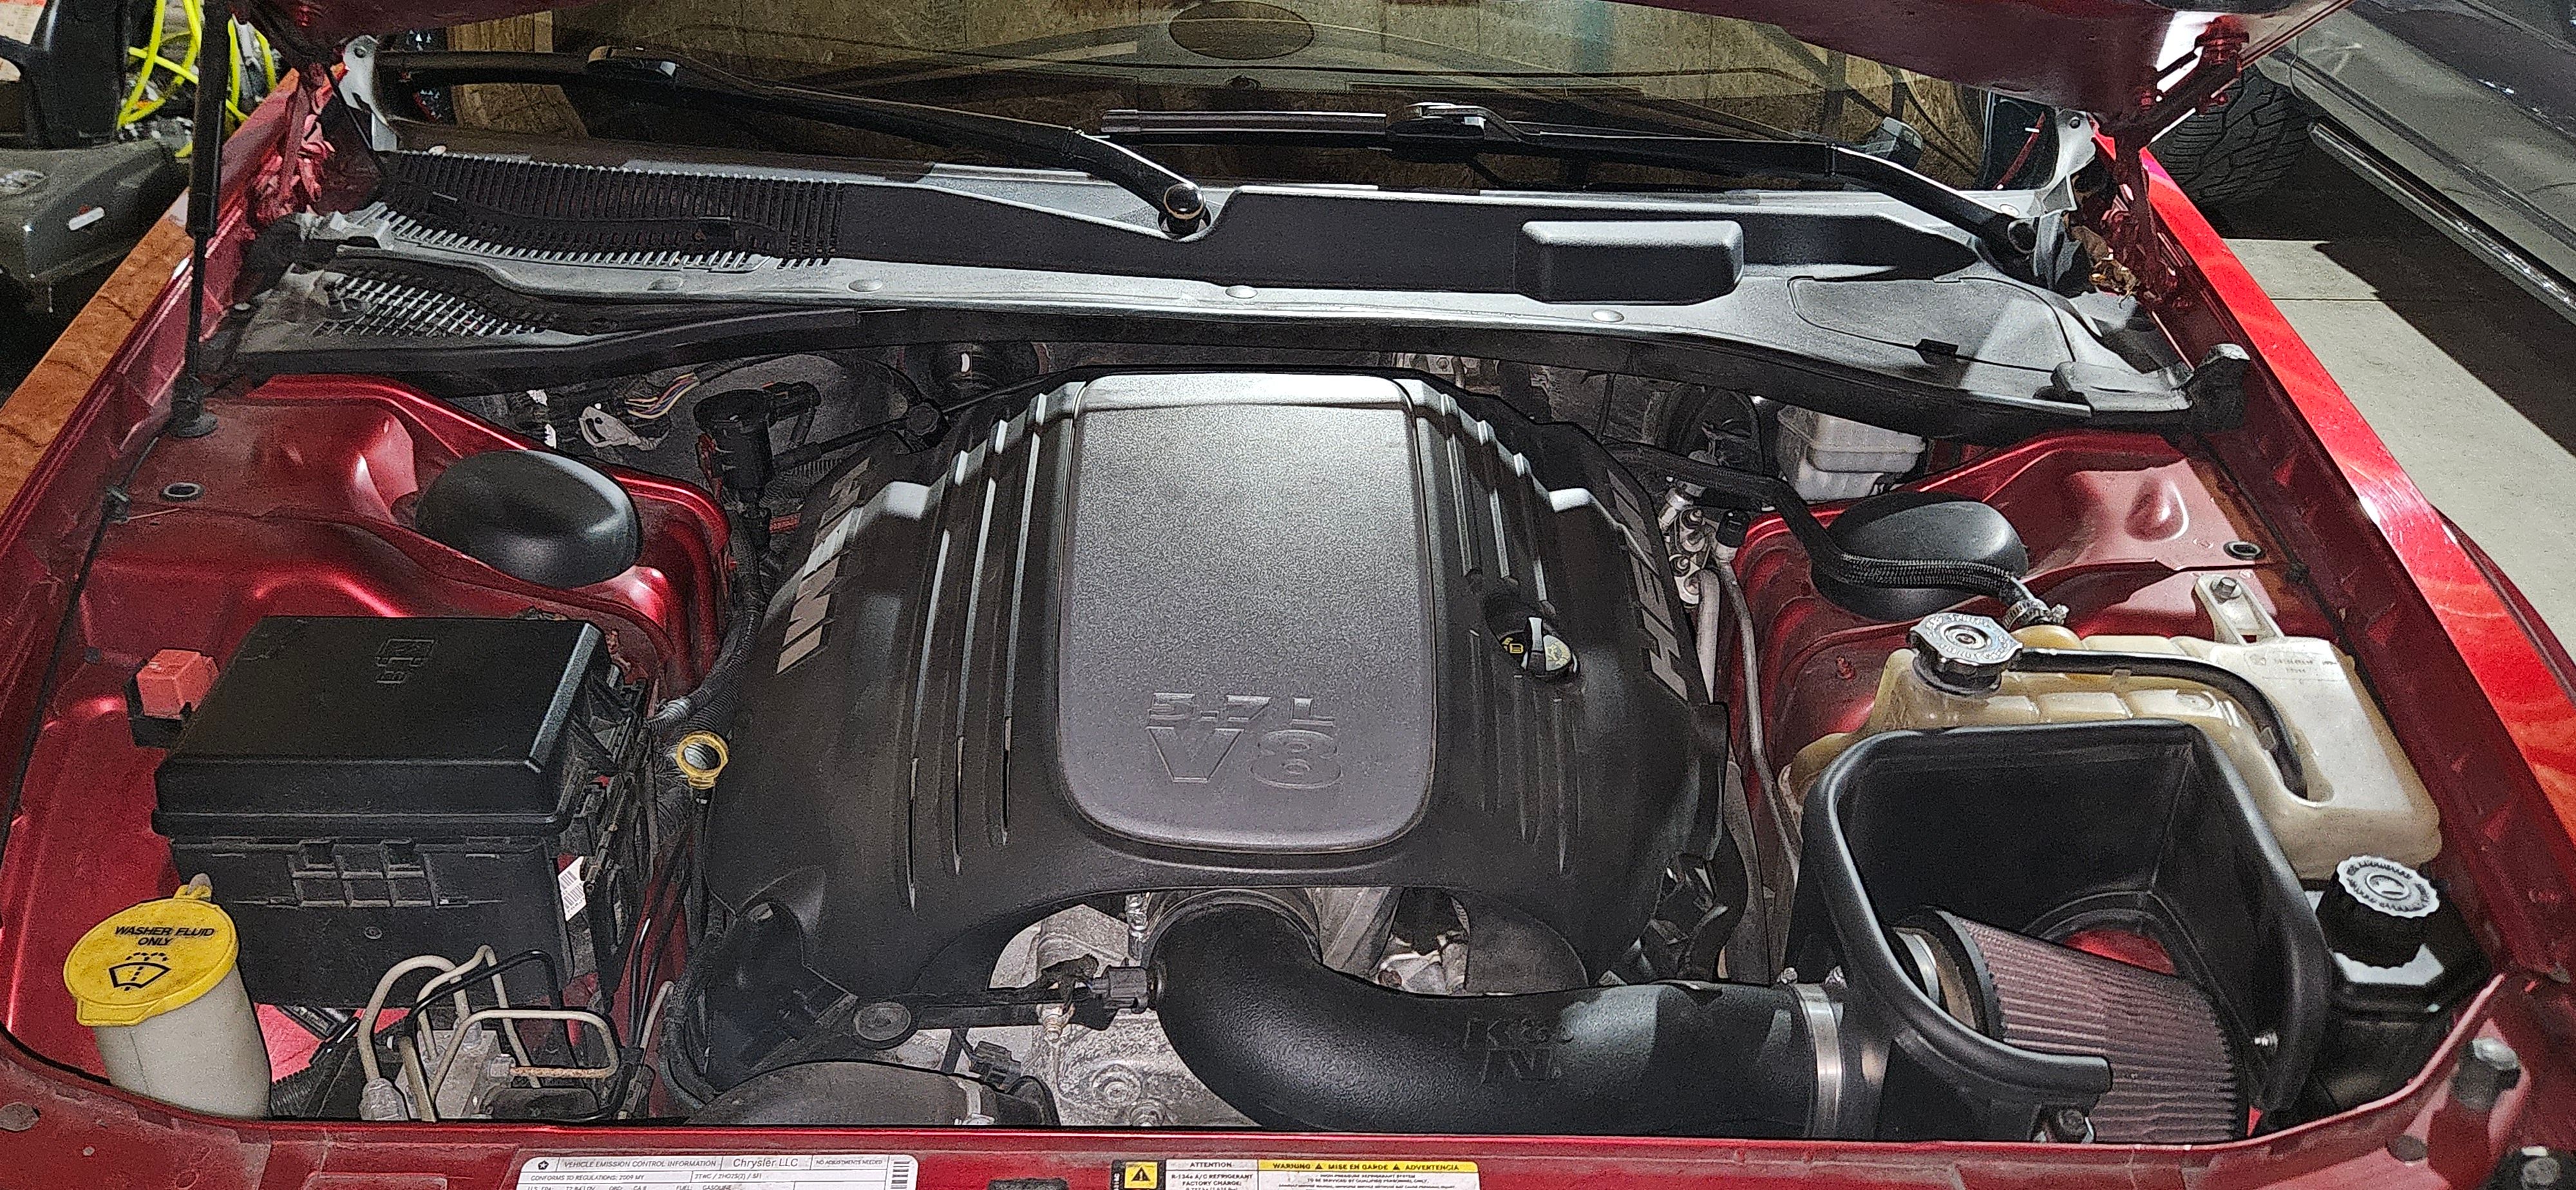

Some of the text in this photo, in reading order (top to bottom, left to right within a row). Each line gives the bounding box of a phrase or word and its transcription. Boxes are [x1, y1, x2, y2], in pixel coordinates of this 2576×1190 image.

[777, 456, 871, 674] HEMI
[1605, 468, 1689, 701] HEMI
[1144, 726, 1344, 789] V8
[115, 925, 215, 937] WASHER FLUID
[138, 937, 172, 946] ONLY
[733, 1158, 799, 1169] Chrysler LLC
